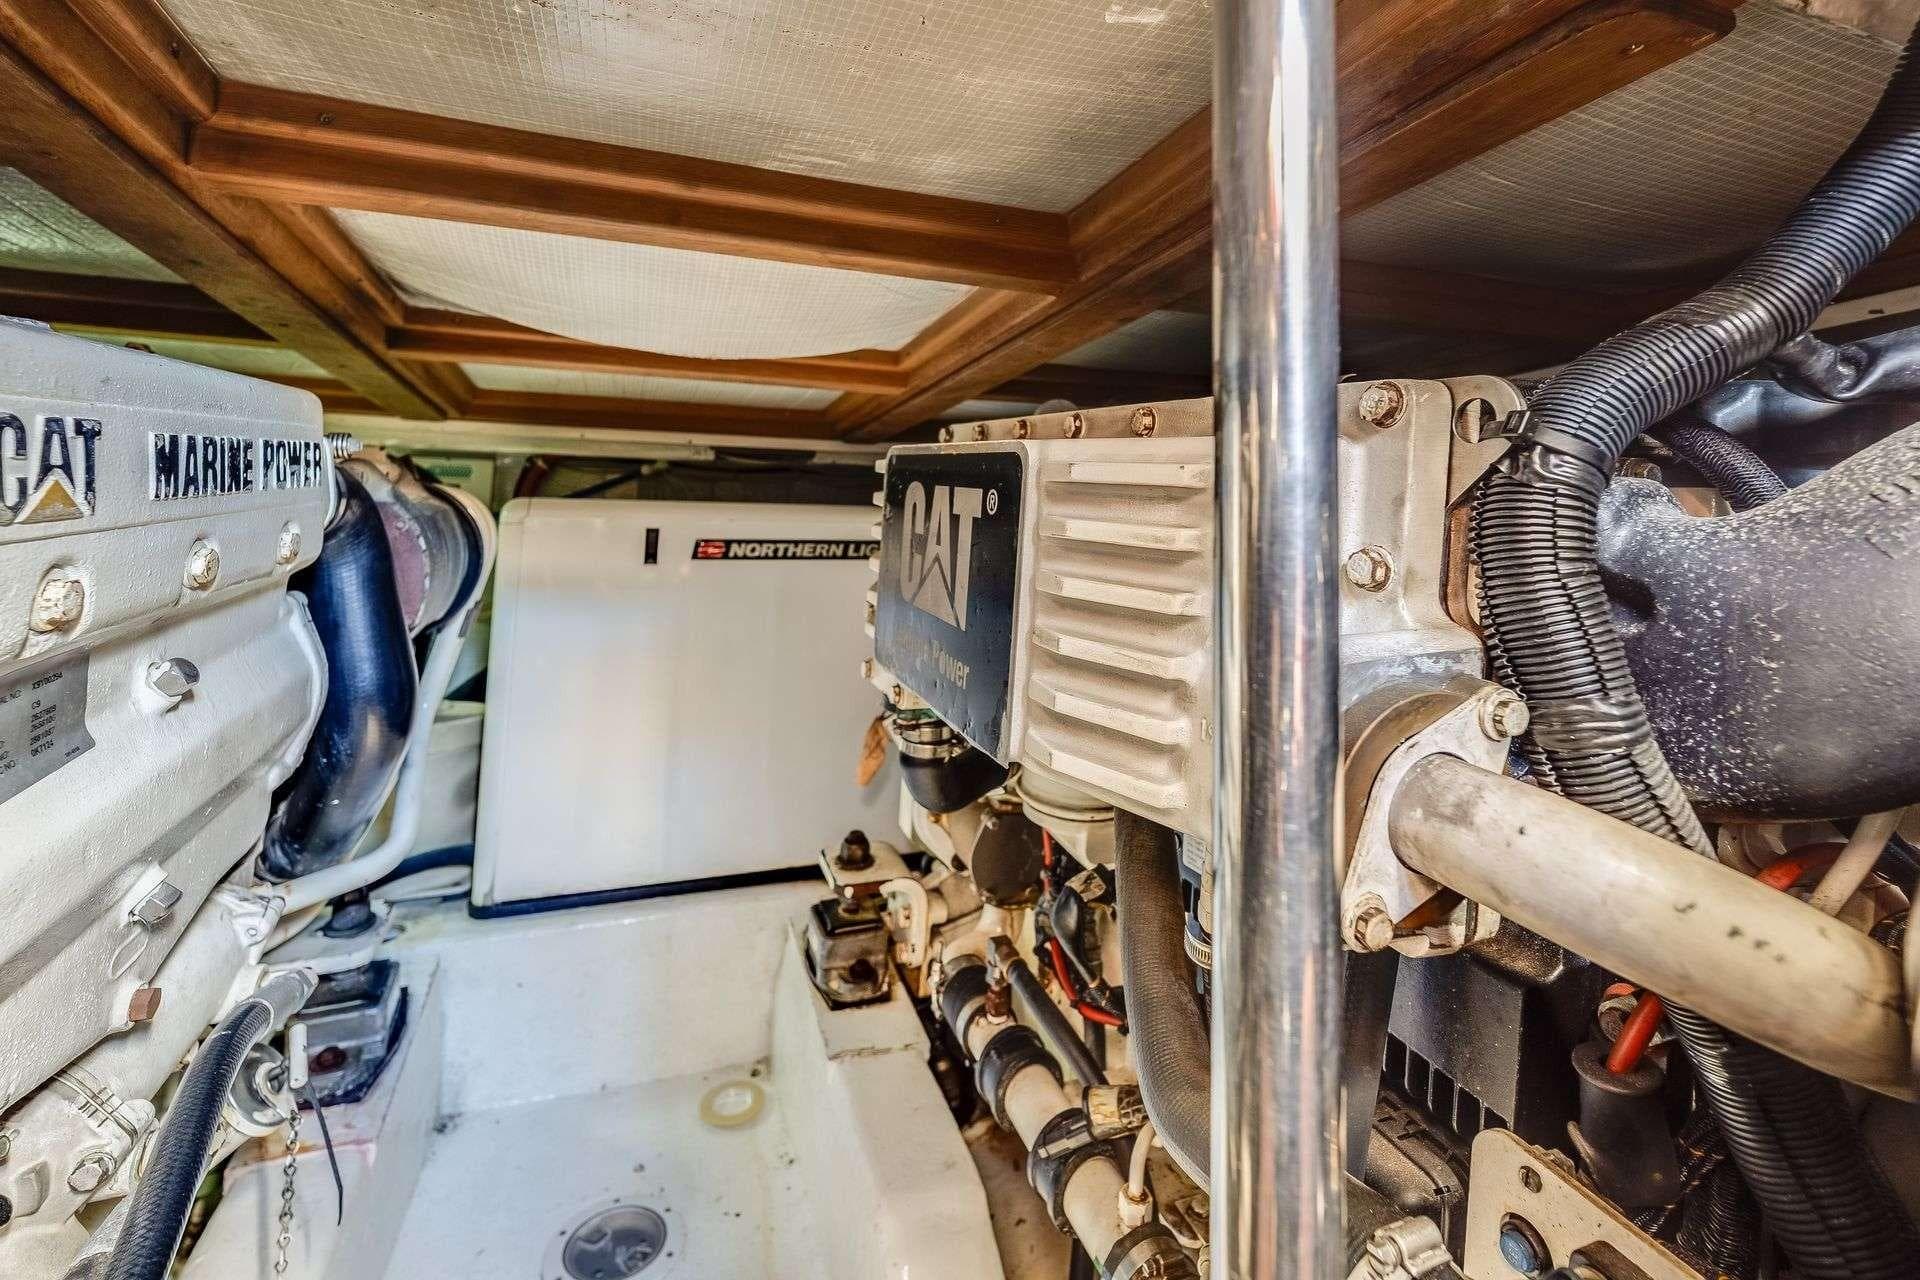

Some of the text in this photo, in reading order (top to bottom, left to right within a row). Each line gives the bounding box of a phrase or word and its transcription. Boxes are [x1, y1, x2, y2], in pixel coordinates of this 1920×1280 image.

[0, 412, 102, 526] CAT
[151, 432, 322, 499] MARINE POWER
[728, 542, 843, 558] NORTHERN
[901, 480, 983, 632] CAT
